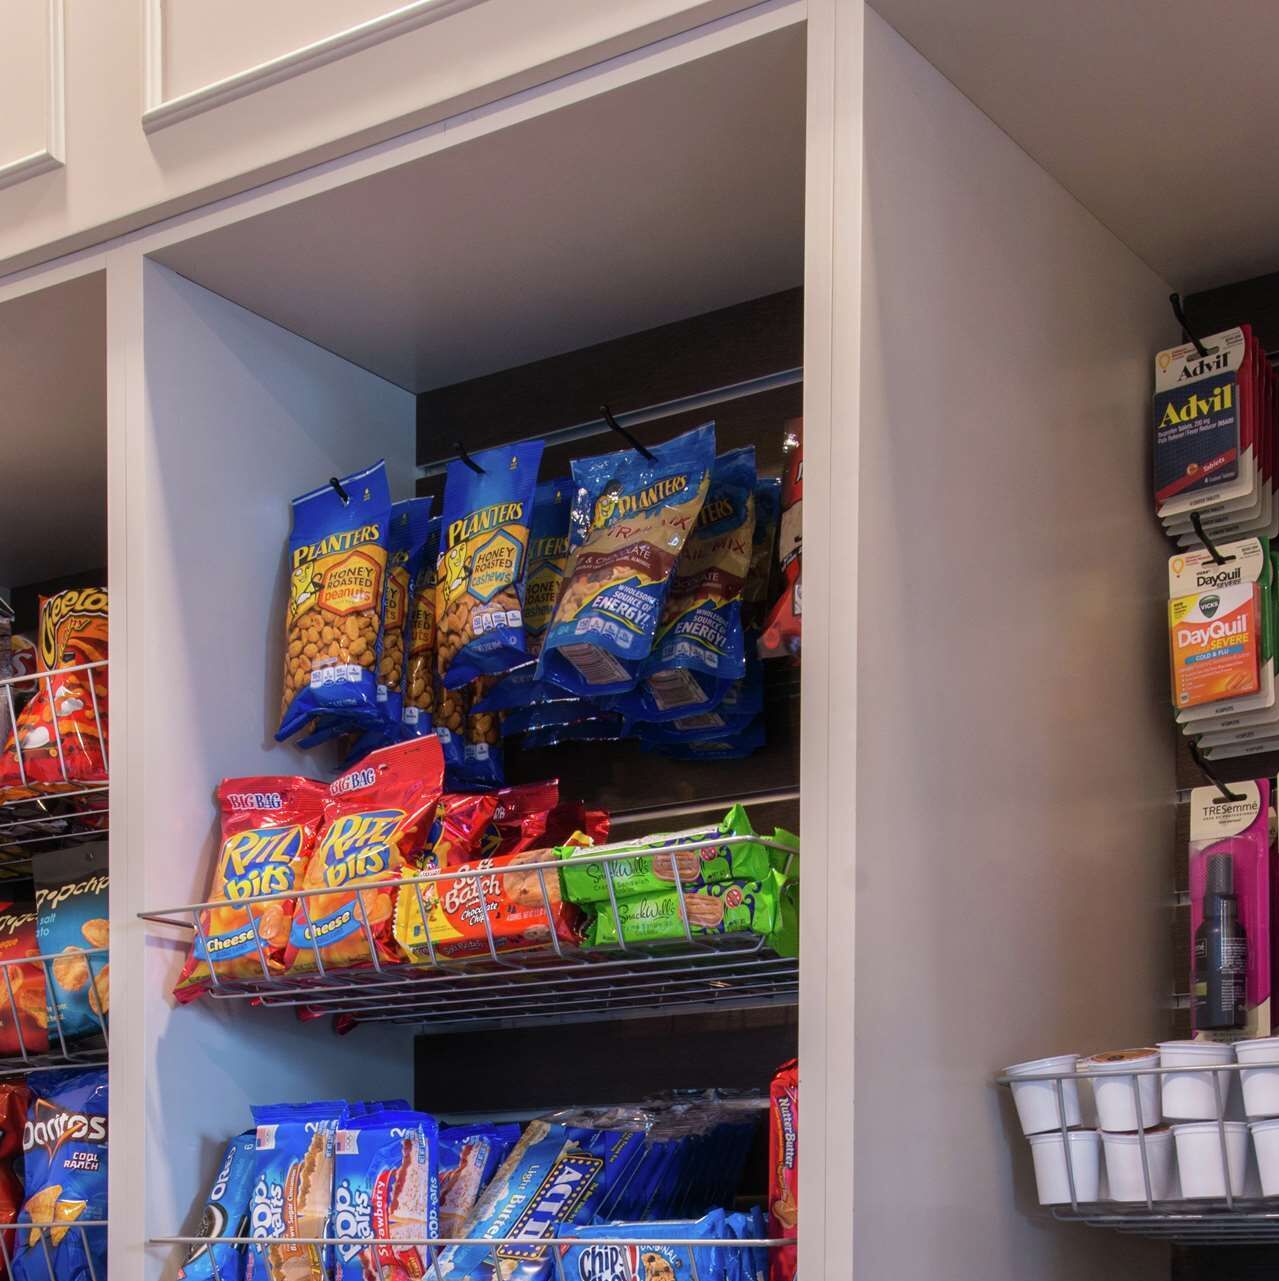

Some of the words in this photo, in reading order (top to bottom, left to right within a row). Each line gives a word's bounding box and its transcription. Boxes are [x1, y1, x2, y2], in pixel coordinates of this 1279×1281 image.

[1178, 352, 1230, 382] Advil
[1158, 384, 1233, 429] Advil
[620, 474, 687, 513] PLANTERS
[448, 502, 524, 547] PLANTERS
[293, 524, 380, 564] PLANTERS
[478, 547, 515, 563] HONEY
[329, 567, 373, 585] HONEY
[474, 559, 513, 575] ROASTED
[1197, 568, 1241, 587] DayQuil
[327, 576, 373, 589] ROASTED
[471, 573, 512, 586] cashews
[324, 588, 371, 601] peanuts
[613, 590, 641, 608] SOURCE
[592, 596, 650, 628] ENERGY!
[675, 623, 726, 646] ENERGY!
[1178, 614, 1247, 648] DayQuil
[1211, 633, 1248, 649] SEVERE
[351, 768, 376, 789] BAG
[228, 794, 253, 809] BIG
[254, 793, 281, 810] BAG
[1203, 802, 1258, 817] TRESemmé
[324, 813, 404, 859] RITZ
[221, 829, 301, 875] RITZ
[323, 845, 386, 889] bits
[443, 874, 501, 913] Batch
[618, 899, 675, 925] SnackWell's
[304, 911, 351, 941] Cheese
[206, 930, 255, 952] Cheese
[23, 1114, 107, 1150] Doritos
[63, 1160, 99, 1171] RANCH
[73, 1152, 99, 1162] COOL
